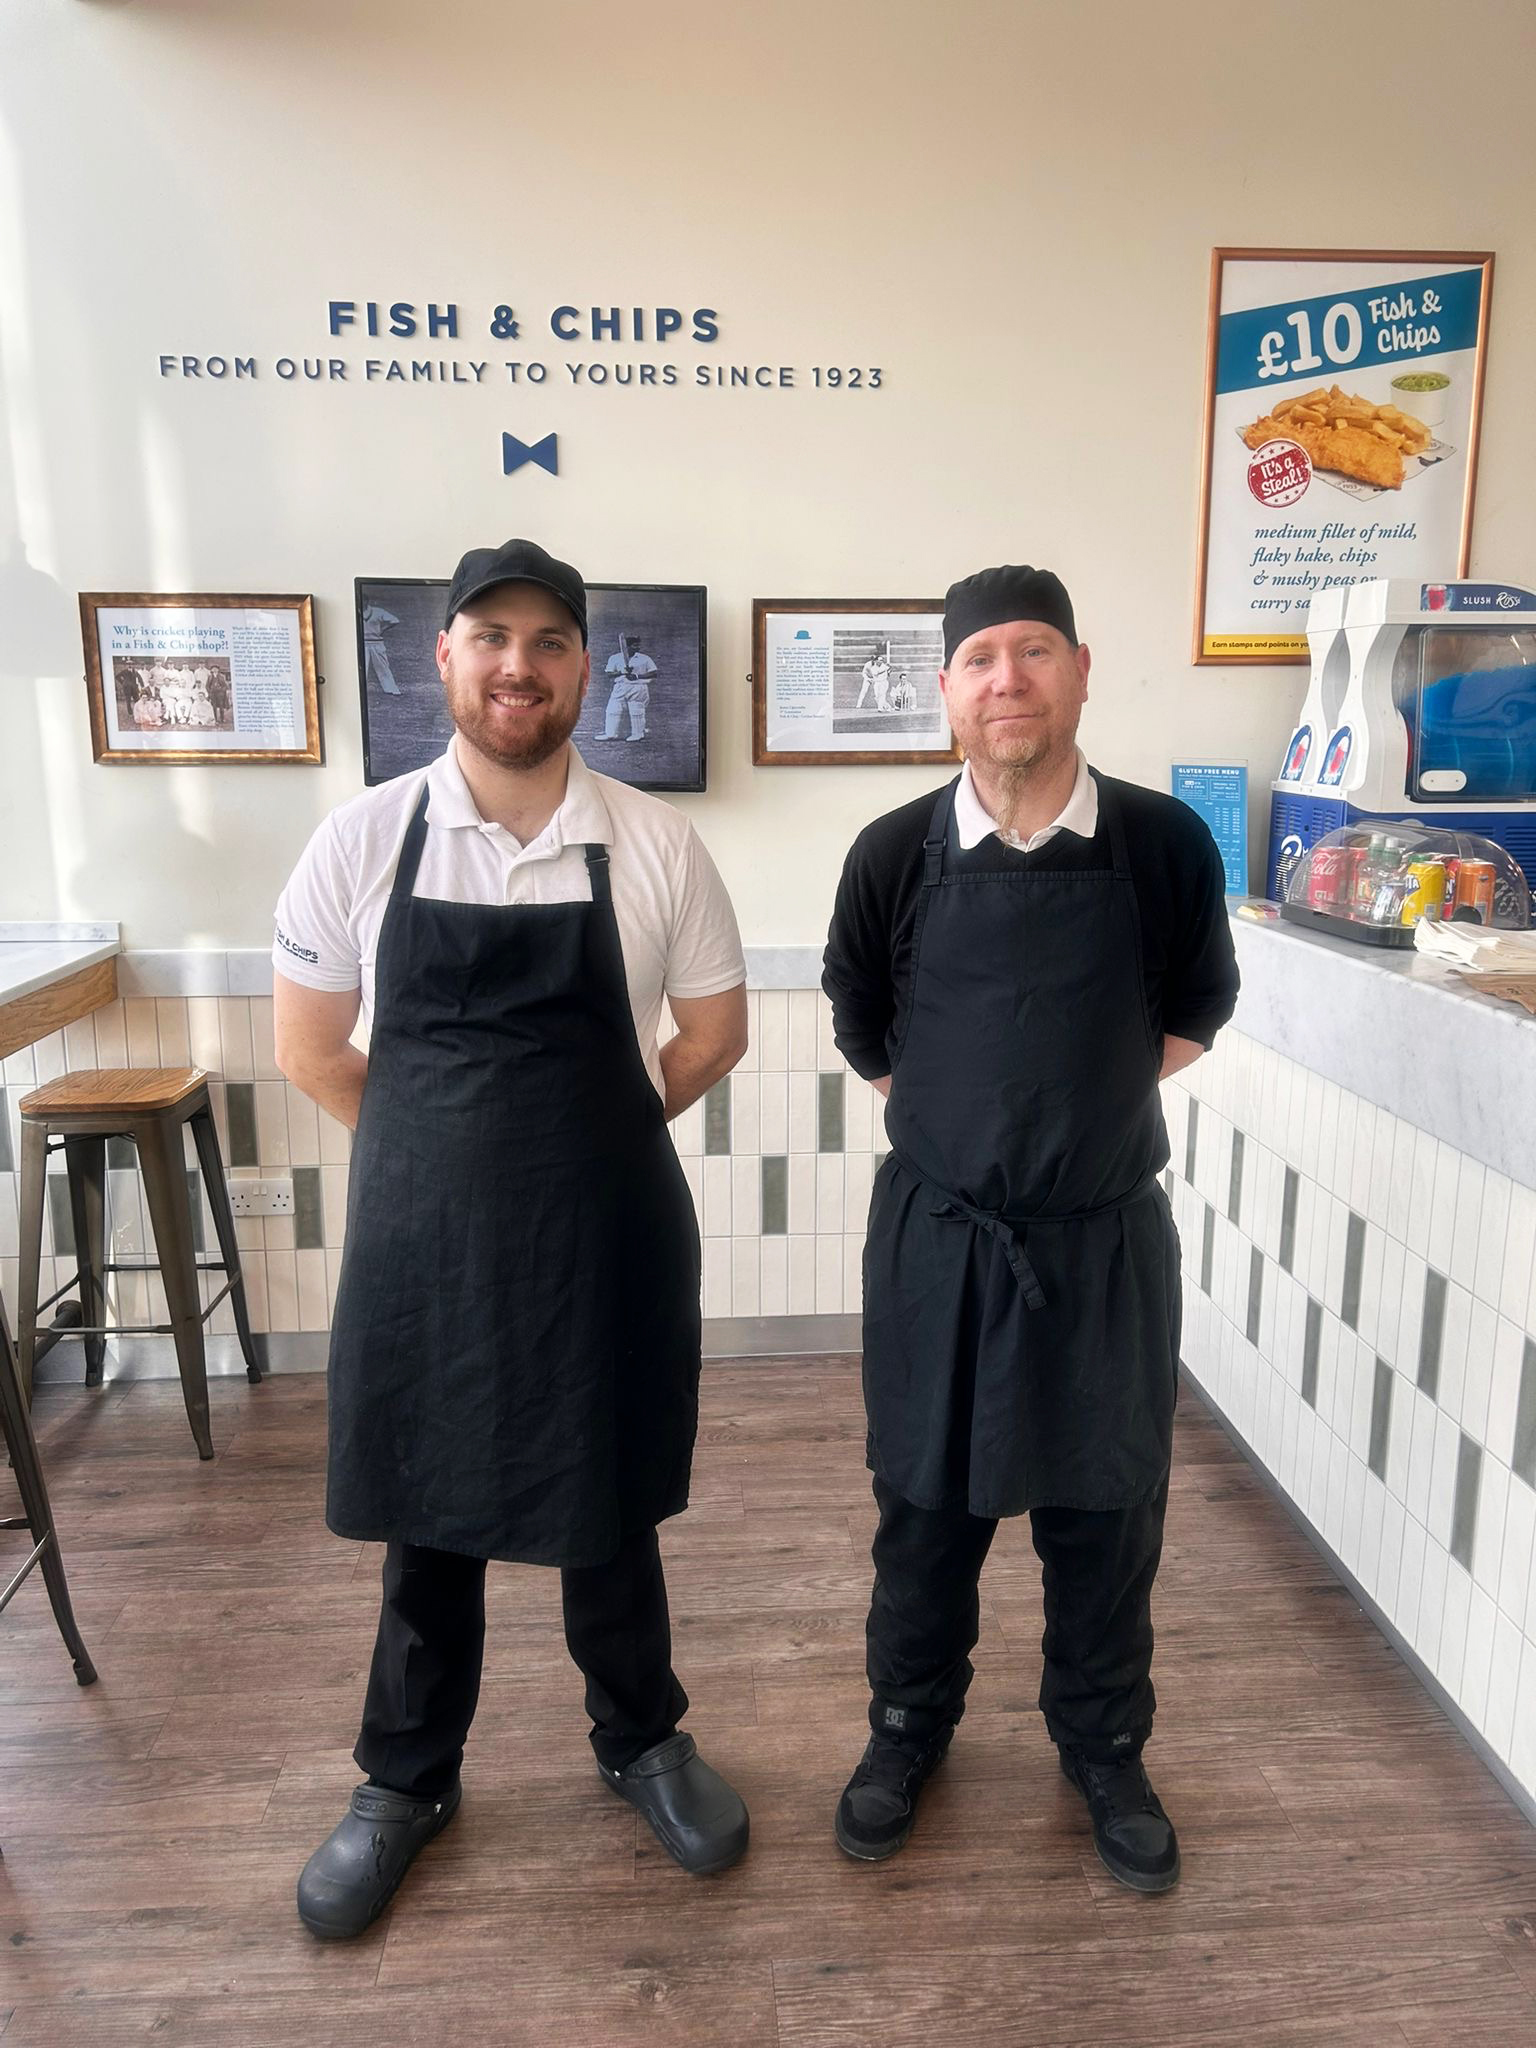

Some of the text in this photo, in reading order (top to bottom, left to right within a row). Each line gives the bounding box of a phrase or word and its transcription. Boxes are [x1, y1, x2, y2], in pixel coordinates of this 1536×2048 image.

[1368, 289, 1442, 324] Fish &
[328, 301, 720, 343] FISH & CHIPS
[1256, 302, 1363, 379] £10
[1377, 323, 1441, 353] Chips
[159, 355, 883, 389] FROM OUR FAMILY TO YOURS SINCE 1923
[1260, 456, 1295, 479] It's a
[1254, 523, 1418, 543] medium fillet of mild,
[1249, 547, 1378, 567] flaky hake, chips
[1253, 570, 1269, 586] &
[1271, 571, 1321, 590] mushy
[1321, 576, 1357, 590] peas
[1250, 600, 1292, 613] curry
[1463, 597, 1491, 605] SLUSH
[113, 625, 226, 638] Why is cricket playing
[112, 640, 122, 649] in
[134, 640, 155, 649] Fish
[157, 641, 167, 649] &
[170, 641, 195, 652] Chip
[198, 641, 229, 652] shop?!
[292, 943, 318, 960] CHIPS
